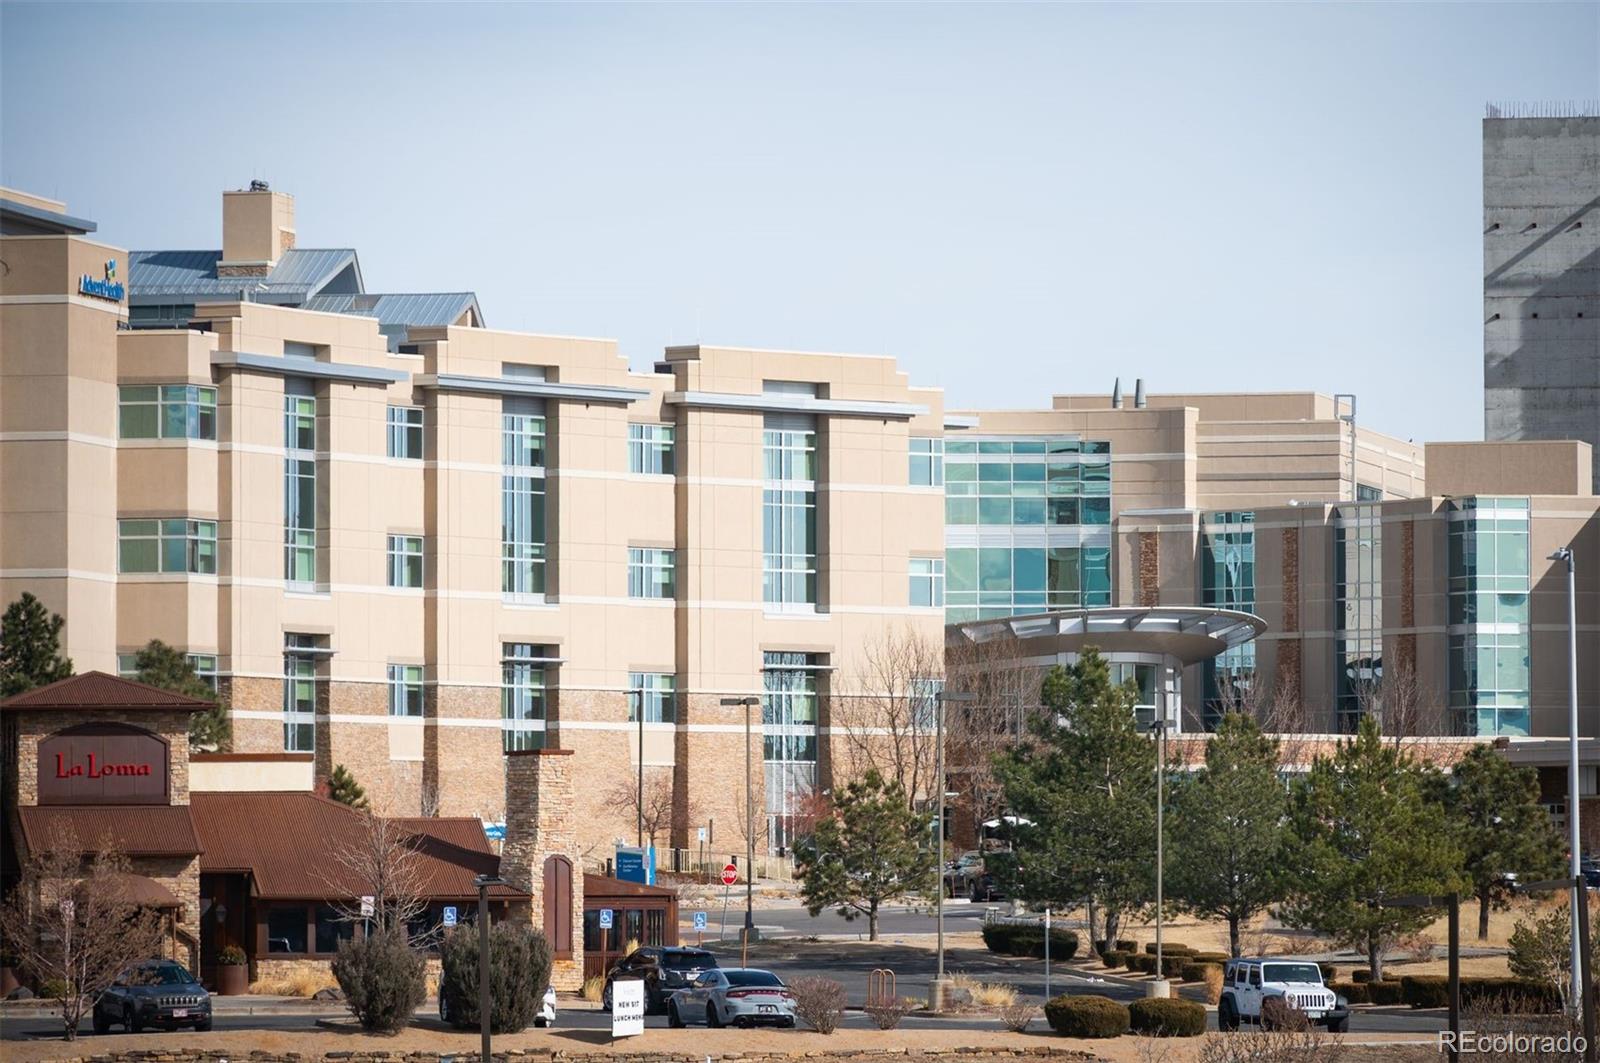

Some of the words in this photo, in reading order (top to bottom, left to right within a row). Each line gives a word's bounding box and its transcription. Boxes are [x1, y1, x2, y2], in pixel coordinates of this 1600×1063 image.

[56, 752, 83, 779] La
[87, 752, 152, 779] Loma
[721, 870, 737, 879] STOP
[613, 1014, 631, 1022] LUNCH
